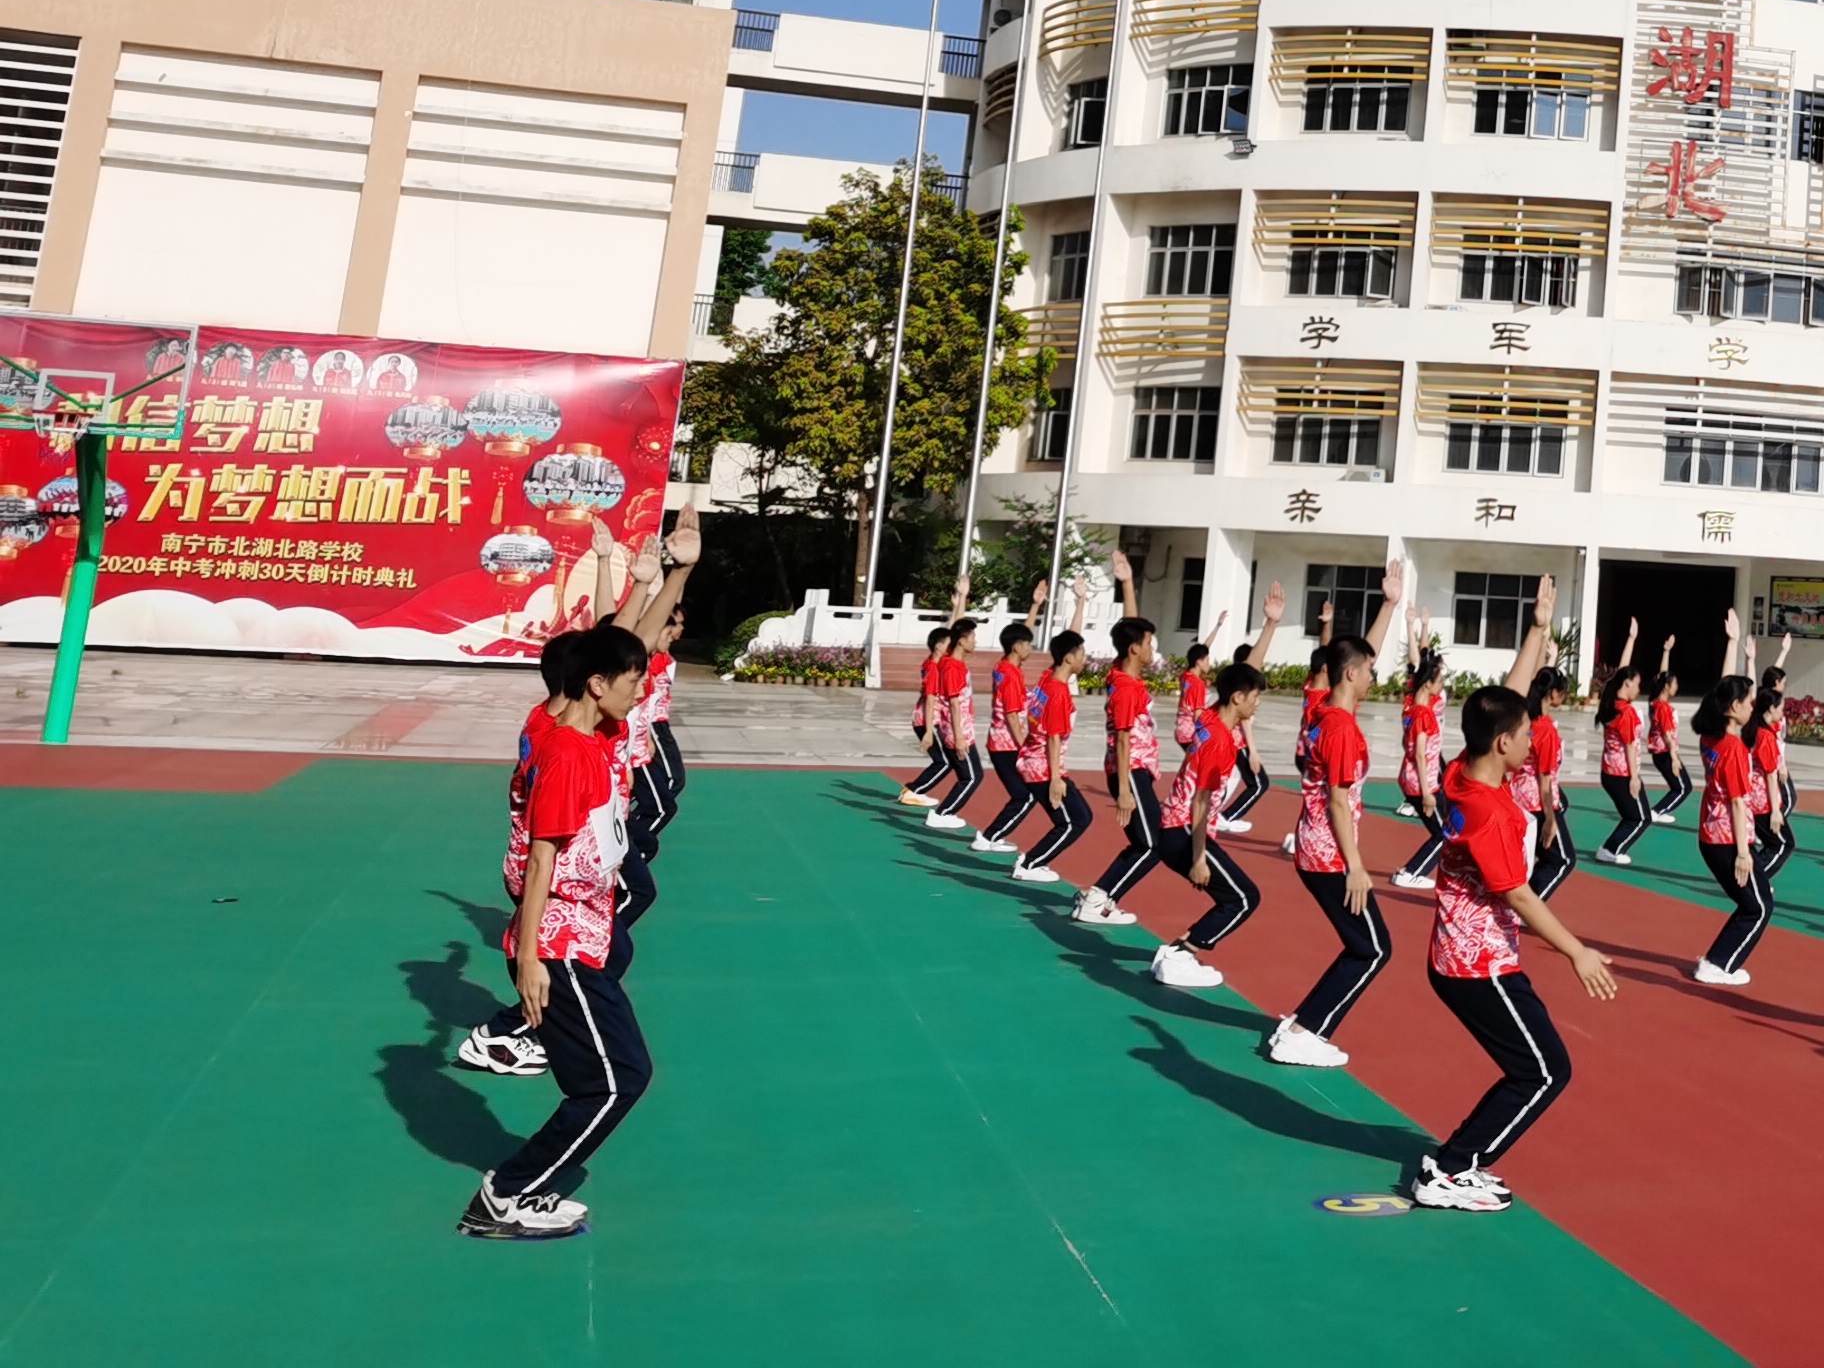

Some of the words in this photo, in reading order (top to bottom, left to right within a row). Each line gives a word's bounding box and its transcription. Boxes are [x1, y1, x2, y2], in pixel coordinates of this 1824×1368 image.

[136, 462, 472, 525] 为梦想而战
[160, 531, 365, 563] 南宁市北湖北路学校
[97, 554, 418, 589] 2020年中考冲刺30天倒计时典礼
